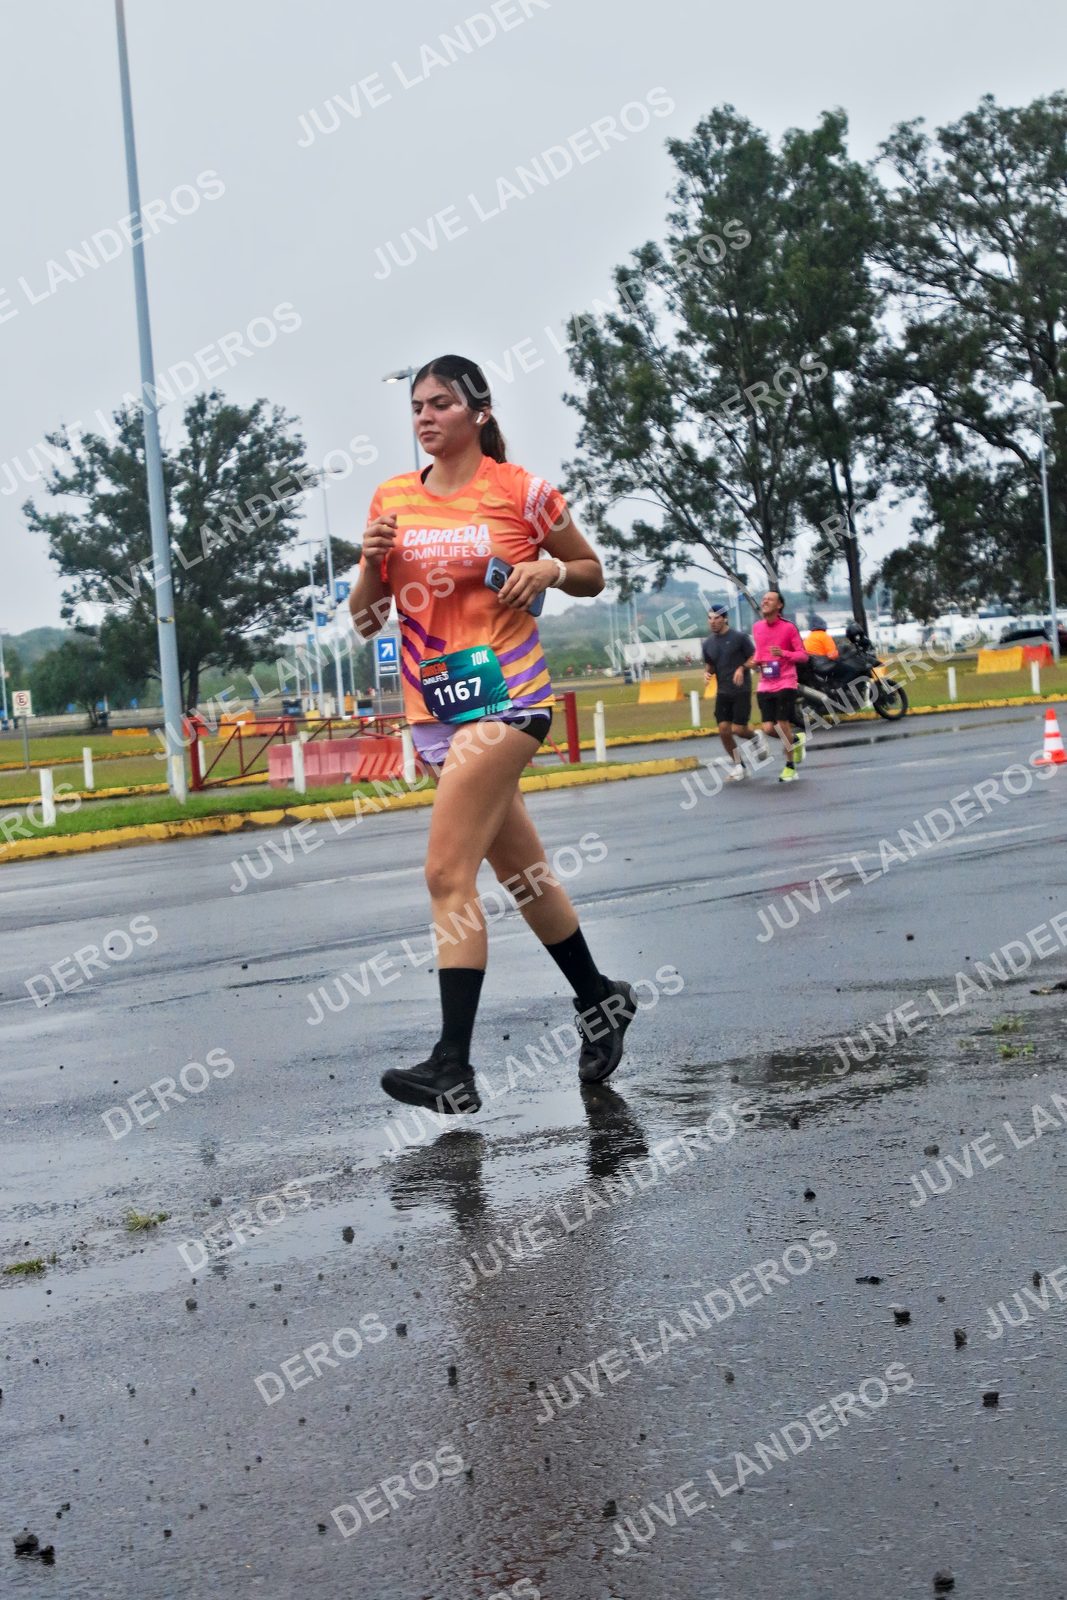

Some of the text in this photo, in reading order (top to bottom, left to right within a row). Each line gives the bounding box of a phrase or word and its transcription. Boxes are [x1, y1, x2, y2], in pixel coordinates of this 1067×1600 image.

[403, 524, 491, 547] CARRERA
[402, 545, 470, 562] OMNILIFE
[470, 650, 490, 666] 10K
[434, 676, 482, 706] 1167
